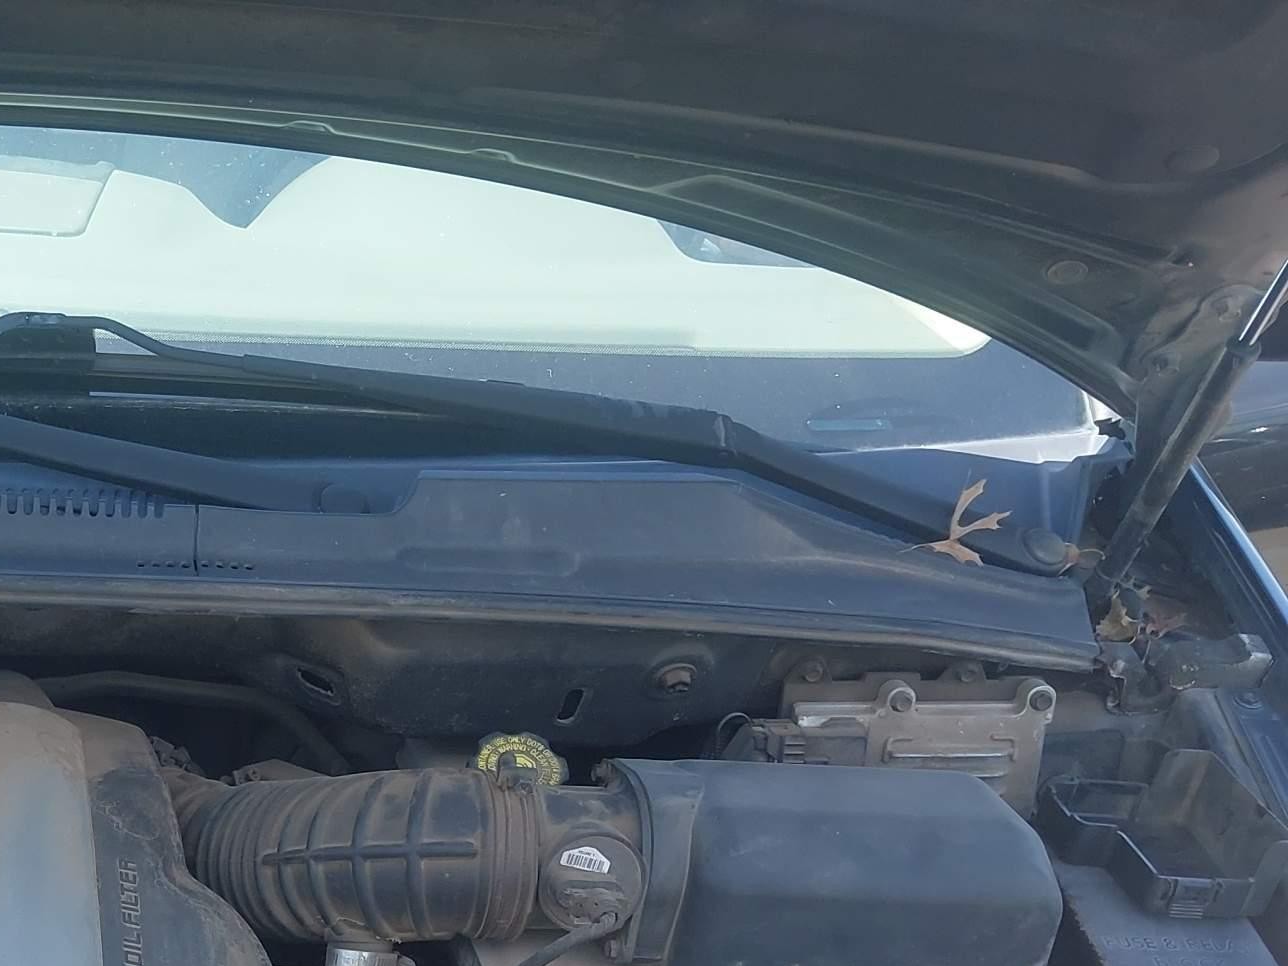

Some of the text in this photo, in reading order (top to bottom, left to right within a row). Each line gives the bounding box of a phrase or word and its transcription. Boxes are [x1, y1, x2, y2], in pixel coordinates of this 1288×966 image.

[508, 736, 525, 744] ONLY
[116, 857, 142, 930] FILTER
[1102, 935, 1157, 951] FUSE
[1162, 936, 1179, 950] &
